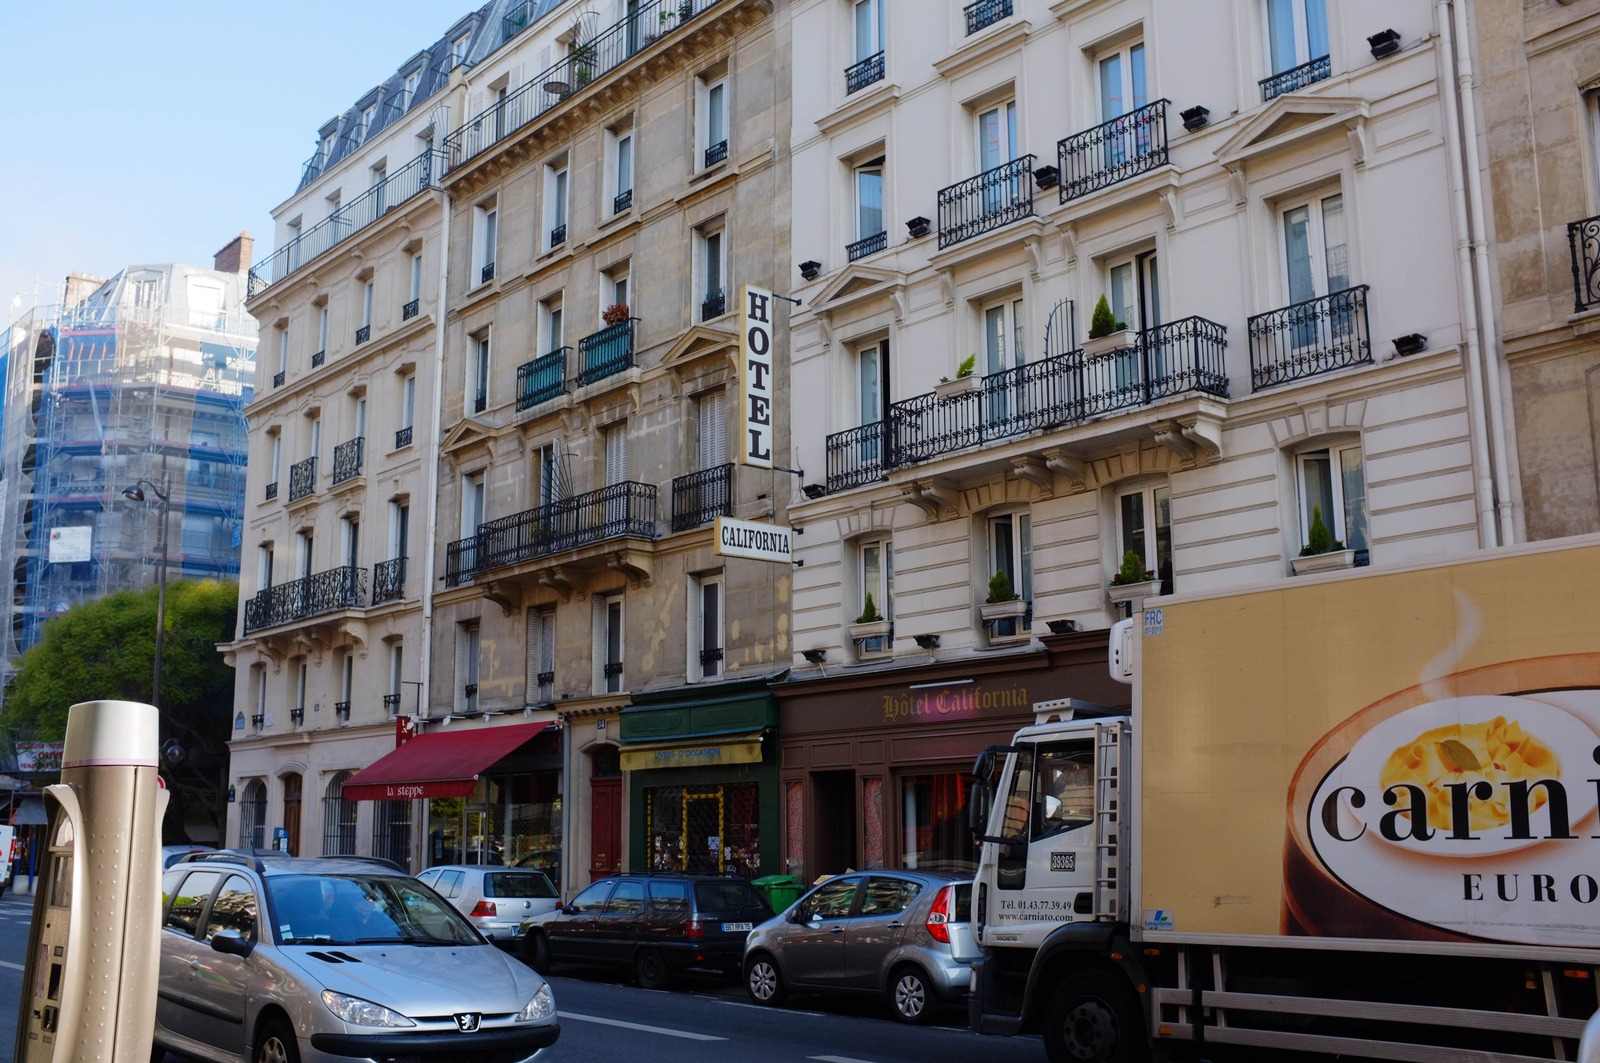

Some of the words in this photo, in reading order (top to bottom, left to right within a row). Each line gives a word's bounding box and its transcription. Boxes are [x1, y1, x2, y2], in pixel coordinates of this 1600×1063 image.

[748, 290, 771, 462] HOTEL
[721, 525, 790, 555] CALIFORNIA
[1144, 609, 1162, 626] FRC
[883, 691, 931, 722] Hôtel
[935, 683, 1028, 714] California
[678, 747, 721, 757] D'OCCASION
[1052, 855, 1074, 869] 39365
[1462, 873, 1599, 904] EURO
[1001, 900, 1016, 910] Tél.
[1018, 900, 1072, 910] 01.43.77.39.49
[998, 911, 1073, 922] www.carniato.com
